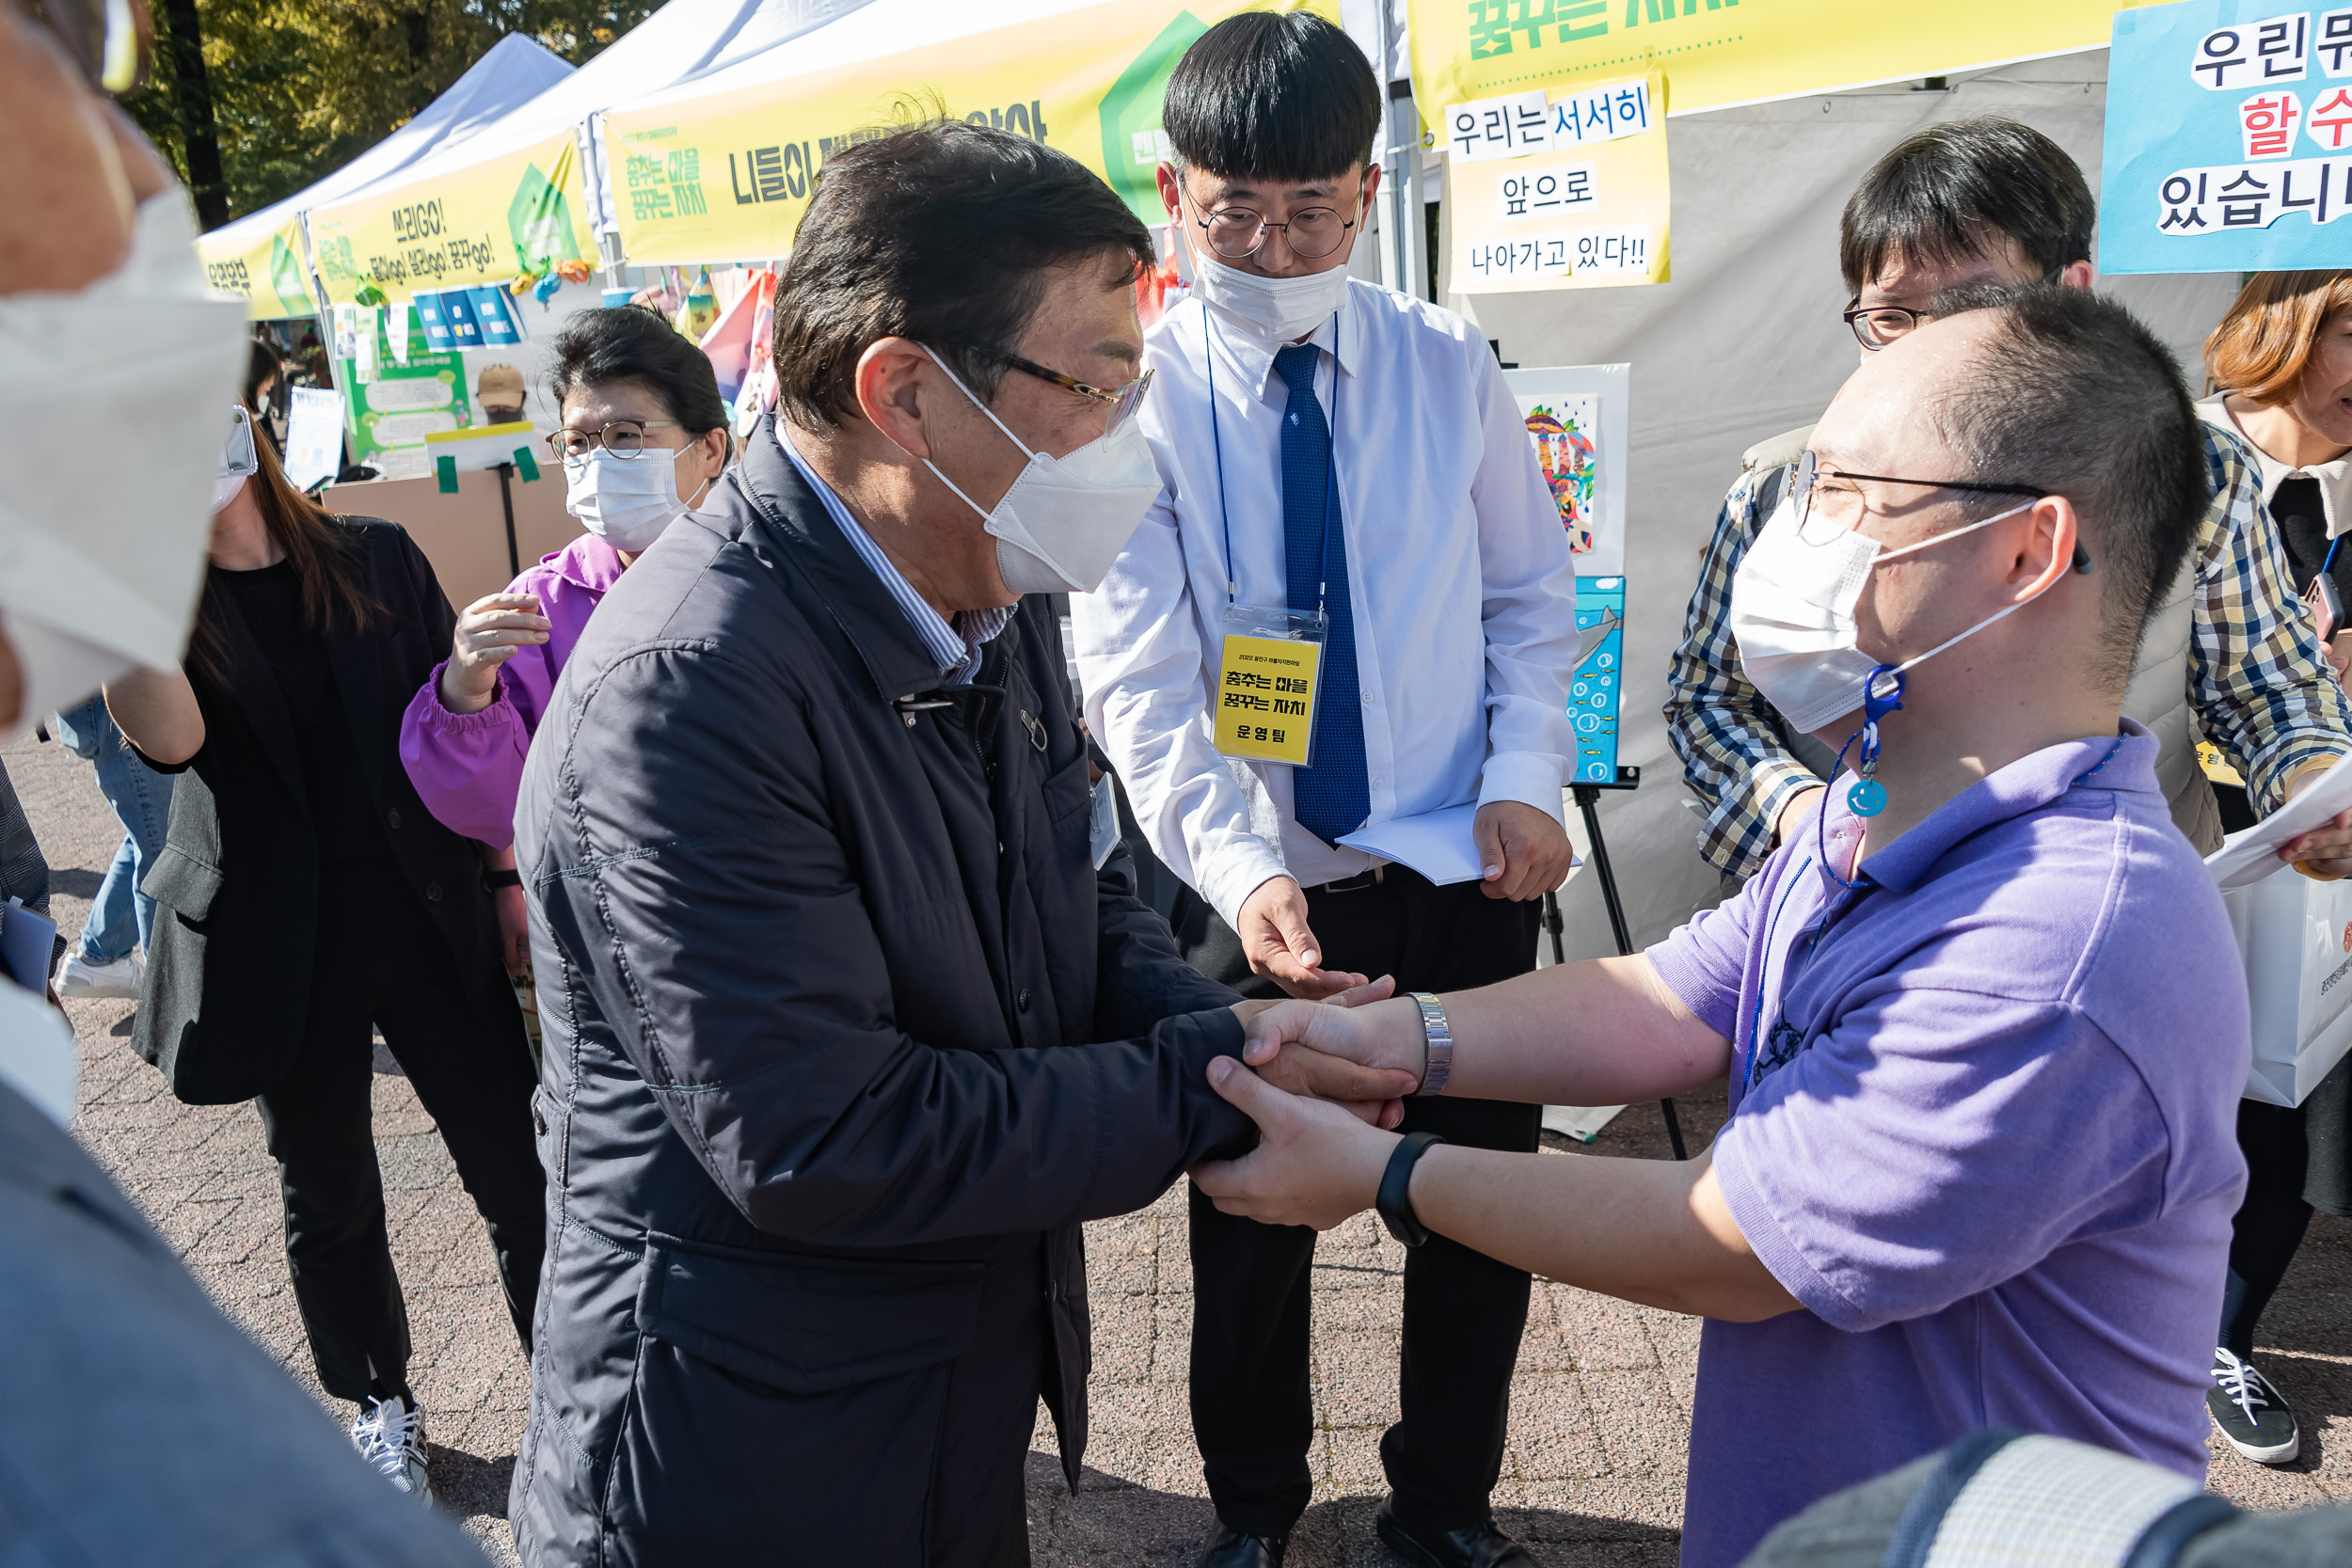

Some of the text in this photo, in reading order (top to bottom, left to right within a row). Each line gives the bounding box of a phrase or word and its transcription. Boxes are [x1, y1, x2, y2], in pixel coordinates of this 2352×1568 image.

[1454, 87, 1646, 154] 우리는 서서히
[626, 148, 699, 187] 춤추는 마을
[630, 182, 707, 221] 꿈꾸는 자치
[1504, 170, 1593, 215] 앞으로
[2160, 164, 2352, 230] 있습니
[1471, 235, 1645, 276] 나아가고 있다!!
[1226, 671, 1308, 694] 춤추는 마을
[1224, 692, 1306, 717] 꿈꾸는 자치
